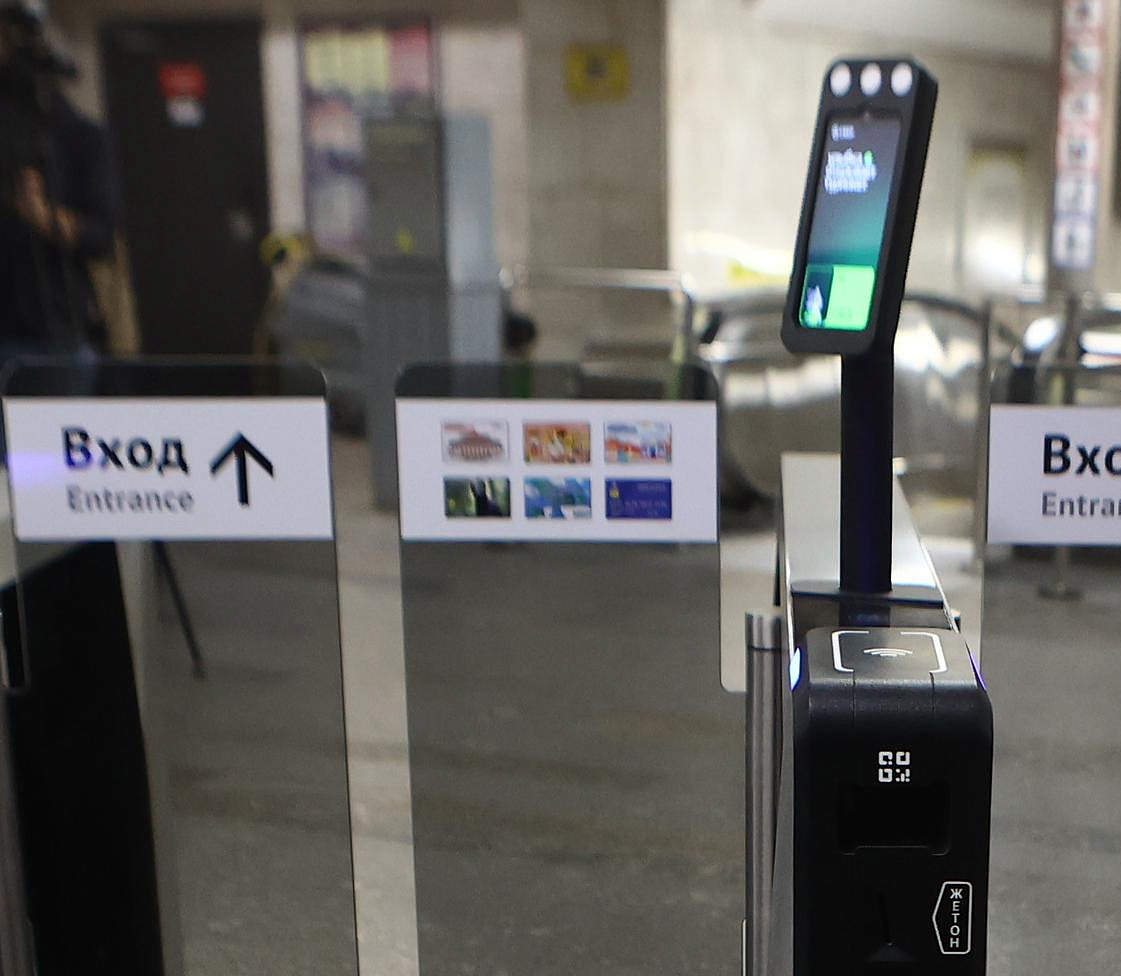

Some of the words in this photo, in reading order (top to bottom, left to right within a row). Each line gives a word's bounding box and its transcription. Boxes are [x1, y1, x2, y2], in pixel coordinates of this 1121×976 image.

[61, 426, 189, 475] Вход
[67, 485, 193, 514] Entrance
[949, 888, 963, 948] ЖЕТОН
